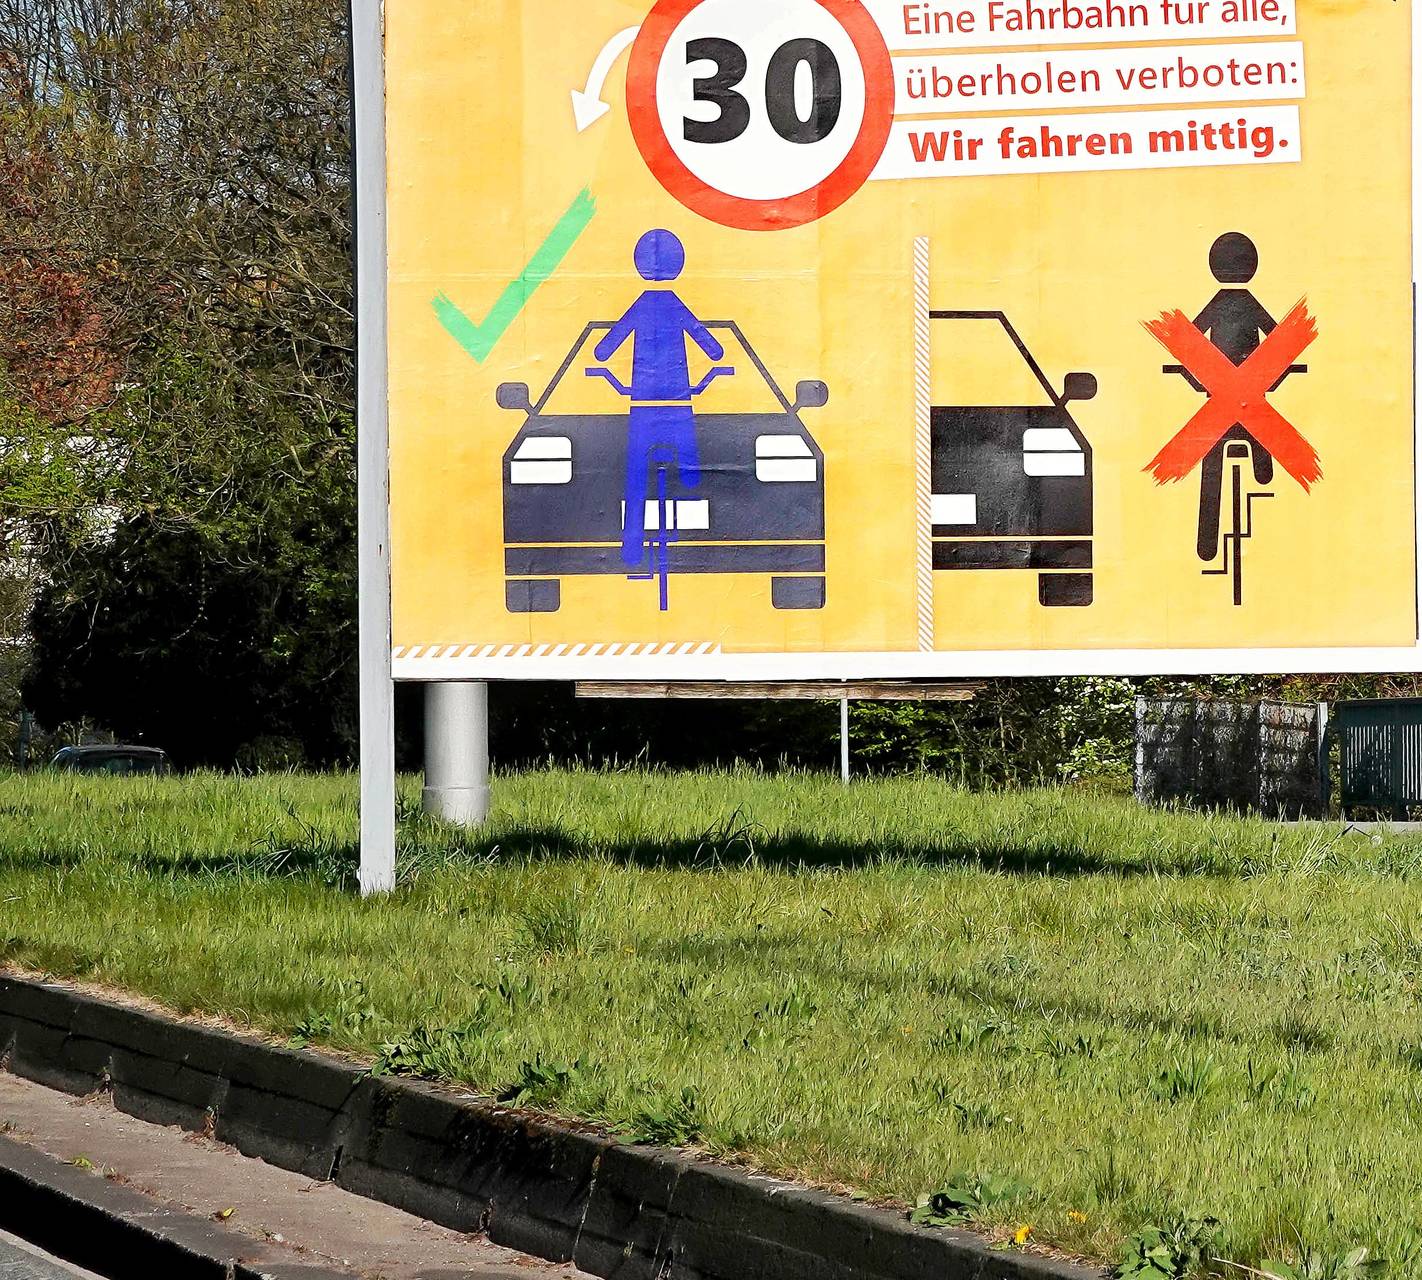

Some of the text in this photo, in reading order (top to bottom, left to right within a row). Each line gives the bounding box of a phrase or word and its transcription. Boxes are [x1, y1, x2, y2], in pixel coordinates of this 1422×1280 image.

[903, 3, 976, 35] Eine
[988, 0, 1148, 32] Fahrbahn
[1221, 0, 1287, 26] alle,
[682, 37, 842, 144] 30
[907, 56, 1299, 98] überholen verboten:
[908, 118, 1289, 163] Wir fahren mittig.
